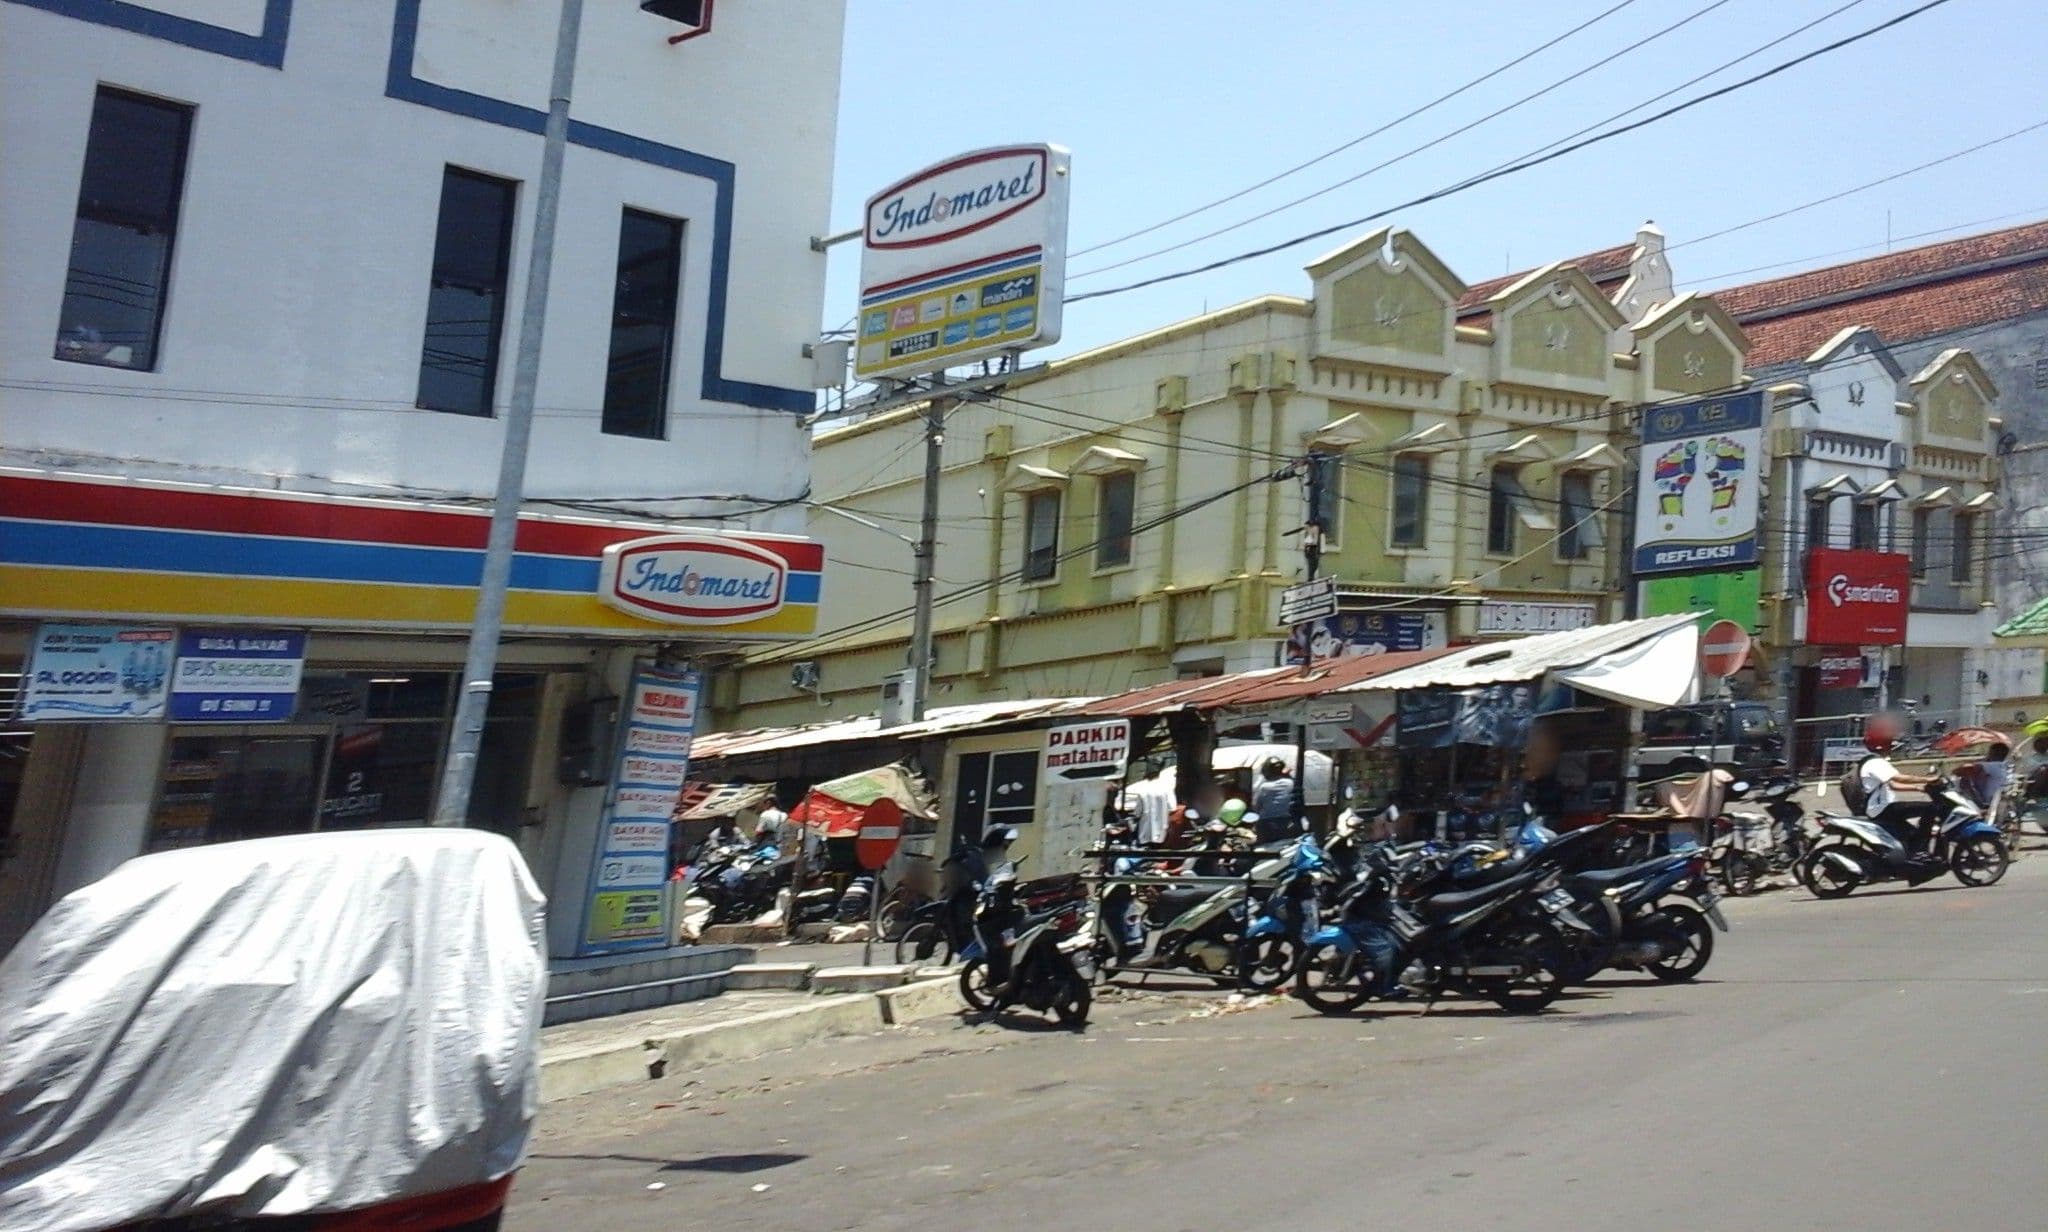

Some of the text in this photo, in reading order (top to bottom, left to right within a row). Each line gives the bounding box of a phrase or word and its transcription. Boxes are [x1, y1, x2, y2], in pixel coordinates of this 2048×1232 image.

[876, 160, 1036, 237] Indomaret
[1656, 545, 1736, 564] REFLEKSI
[626, 556, 775, 599] Indomaret
[1048, 725, 1126, 747] PARKIR
[1046, 745, 1126, 768] matahari
